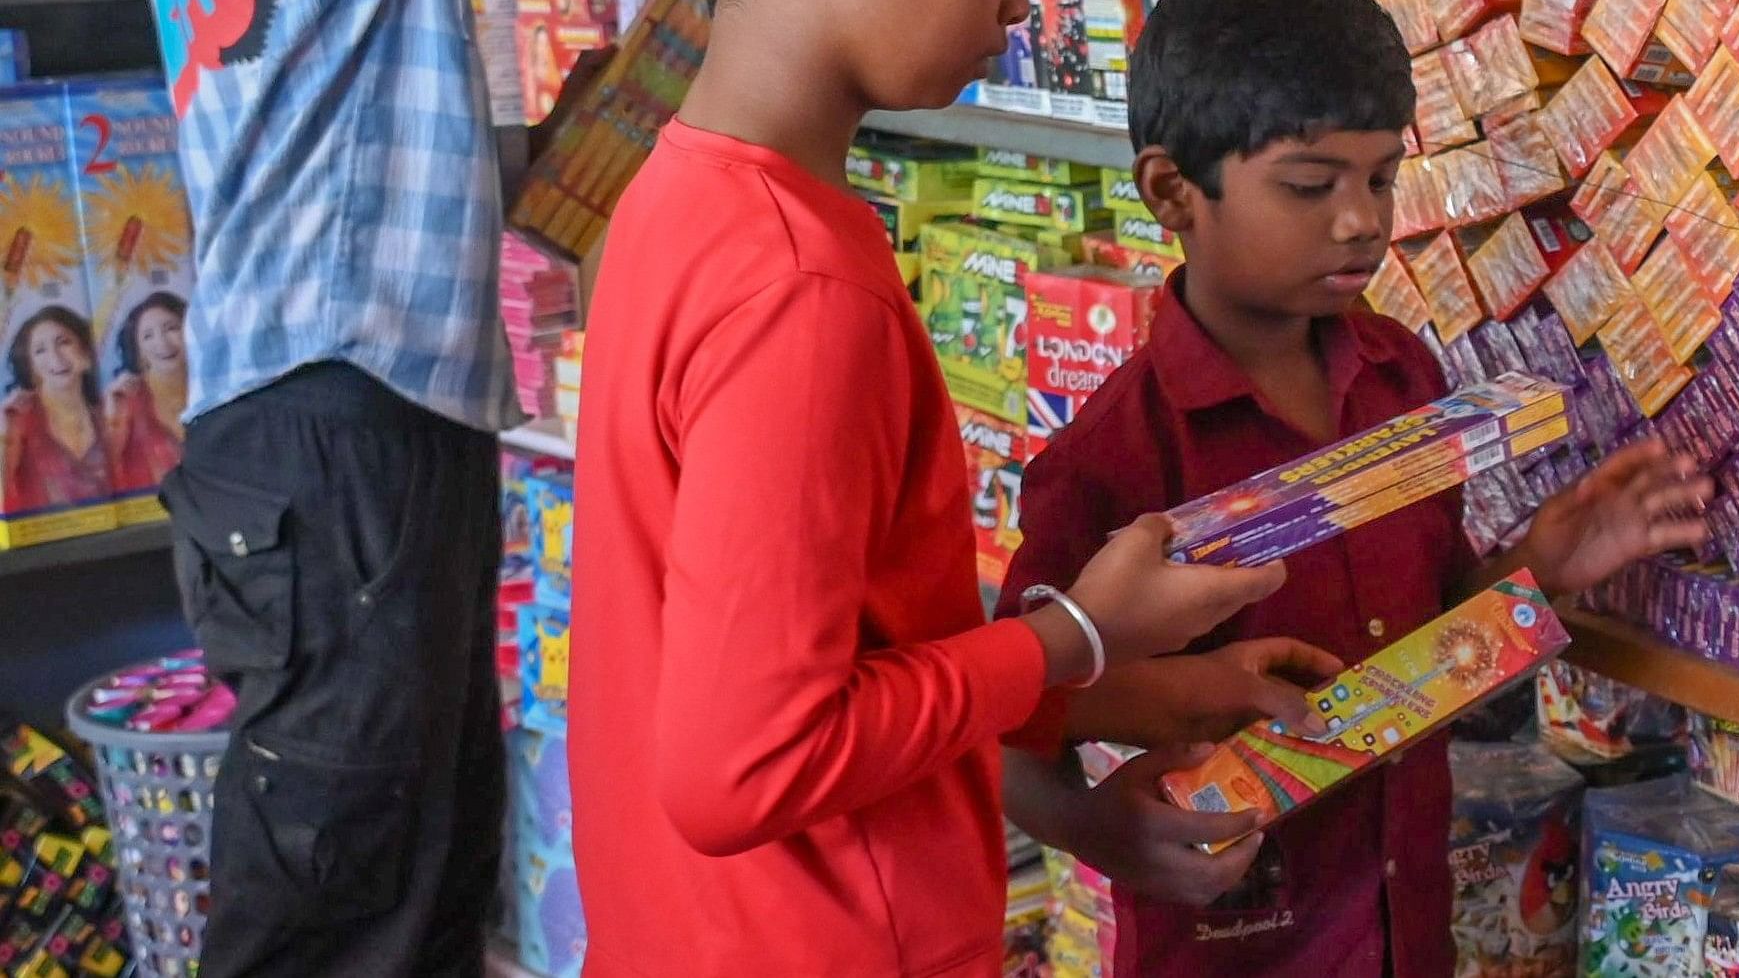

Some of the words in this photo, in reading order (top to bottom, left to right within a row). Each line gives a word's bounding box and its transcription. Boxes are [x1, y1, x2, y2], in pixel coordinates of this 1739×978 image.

[80, 113, 118, 175] 2
[1046, 362, 1107, 390] dream
[1607, 877, 1681, 906] Angry
